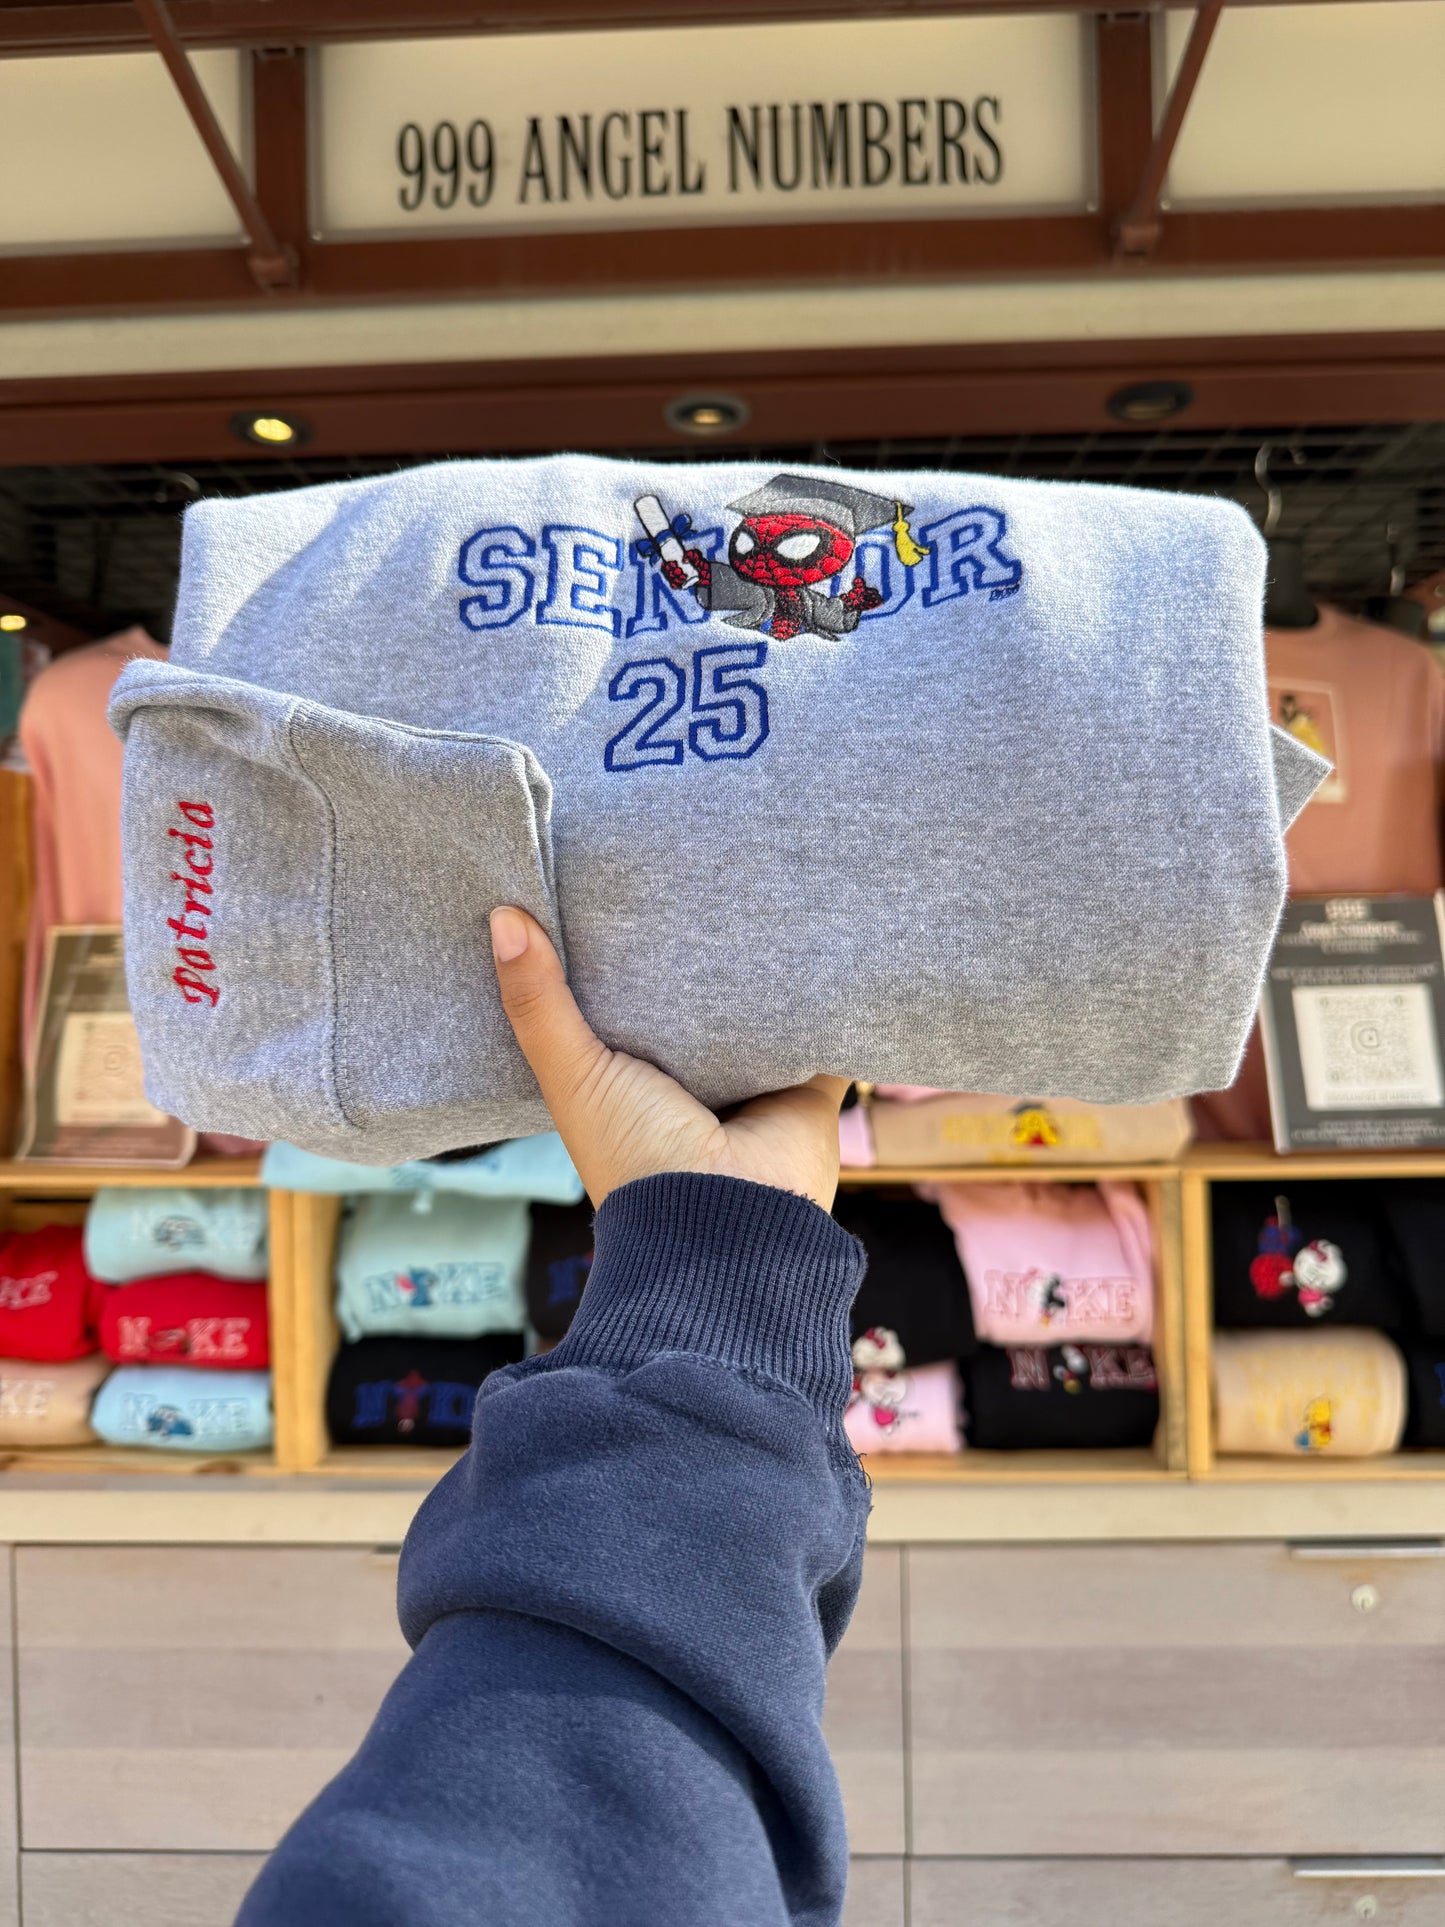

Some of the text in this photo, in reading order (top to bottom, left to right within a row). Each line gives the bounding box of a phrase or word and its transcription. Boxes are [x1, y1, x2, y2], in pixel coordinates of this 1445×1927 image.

[397, 95, 1005, 211] 999 ANGEL NUMBERS
[459, 505, 1022, 637] SENOR
[604, 641, 770, 772] 25
[167, 799, 219, 1008] Patricia
[117, 1316, 250, 1360] NKE
[984, 1268, 1136, 1325] NKE
[1006, 1343, 1156, 1391] NKE
[121, 1392, 249, 1436] NKE
